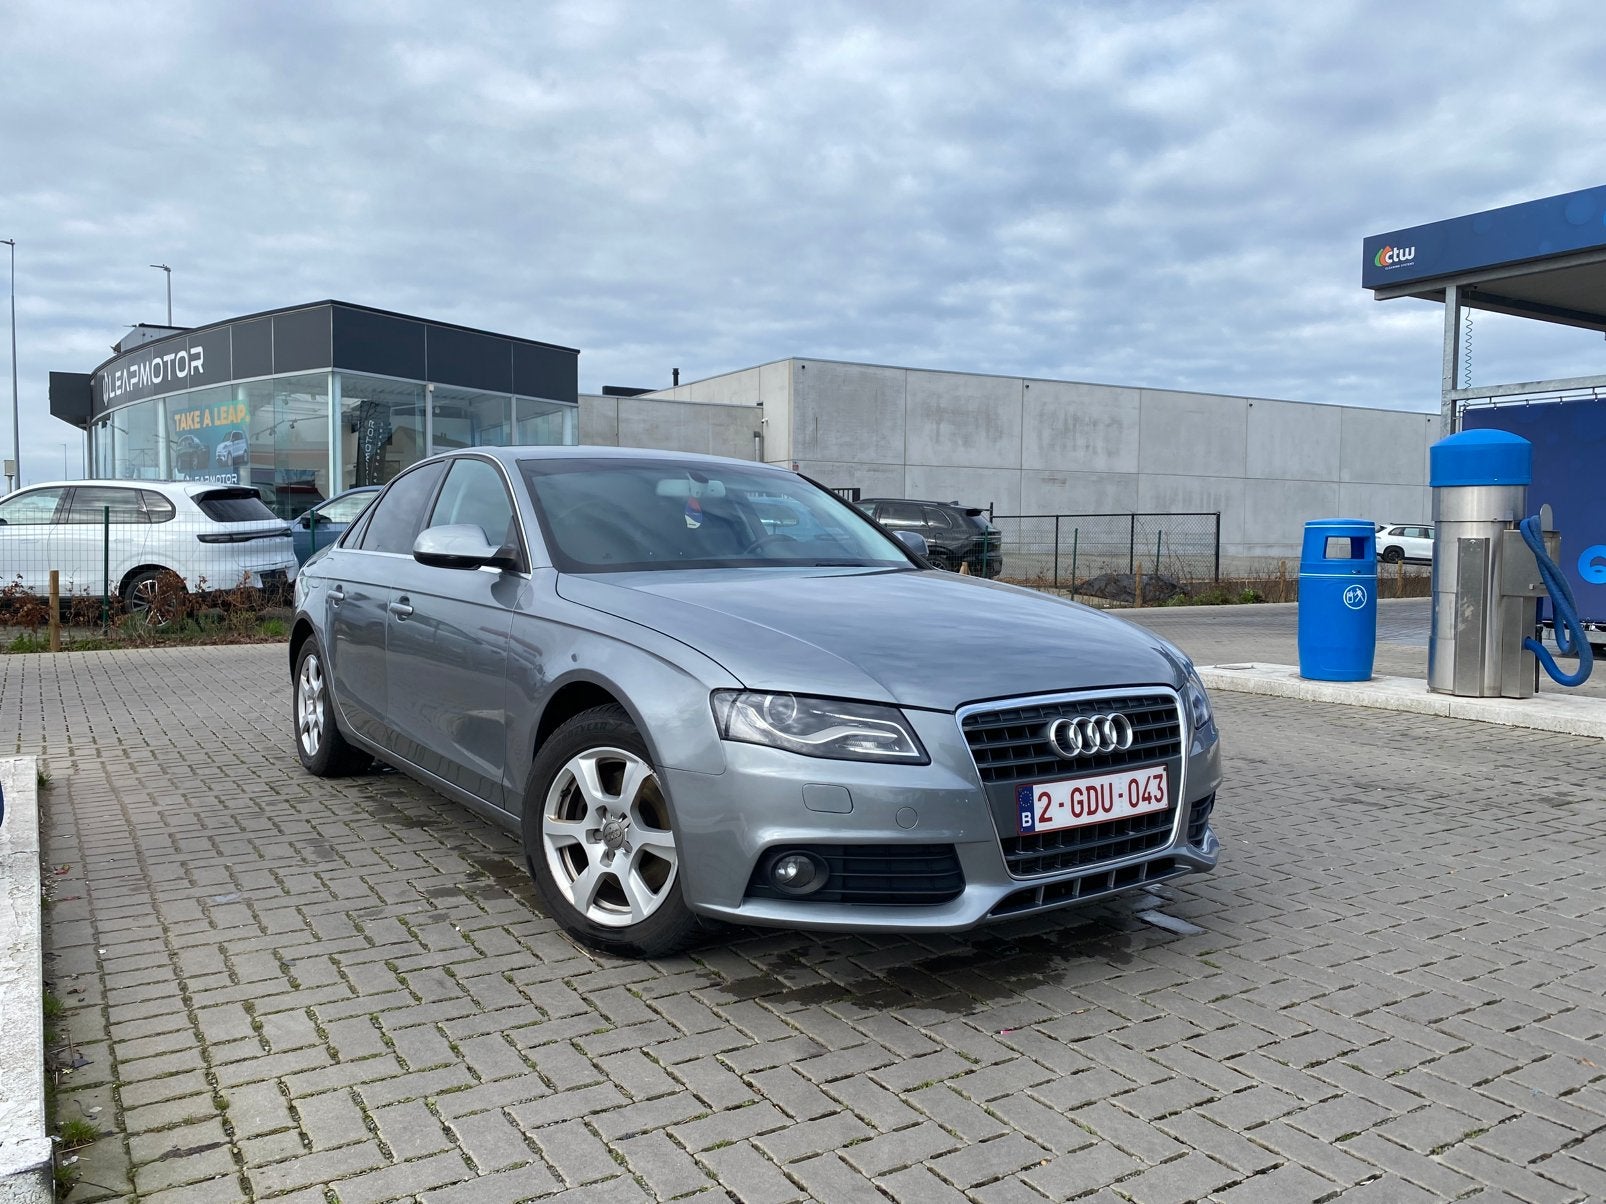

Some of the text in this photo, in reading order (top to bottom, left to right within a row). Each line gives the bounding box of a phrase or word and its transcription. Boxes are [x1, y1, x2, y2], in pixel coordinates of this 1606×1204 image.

[1385, 247, 1415, 263] ctw
[109, 346, 204, 398] LEAPMOTOR
[175, 410, 201, 432] TAKE
[203, 409, 212, 428] A
[1037, 773, 1164, 823] 2-GDU-043
[1021, 812, 1032, 827] B
